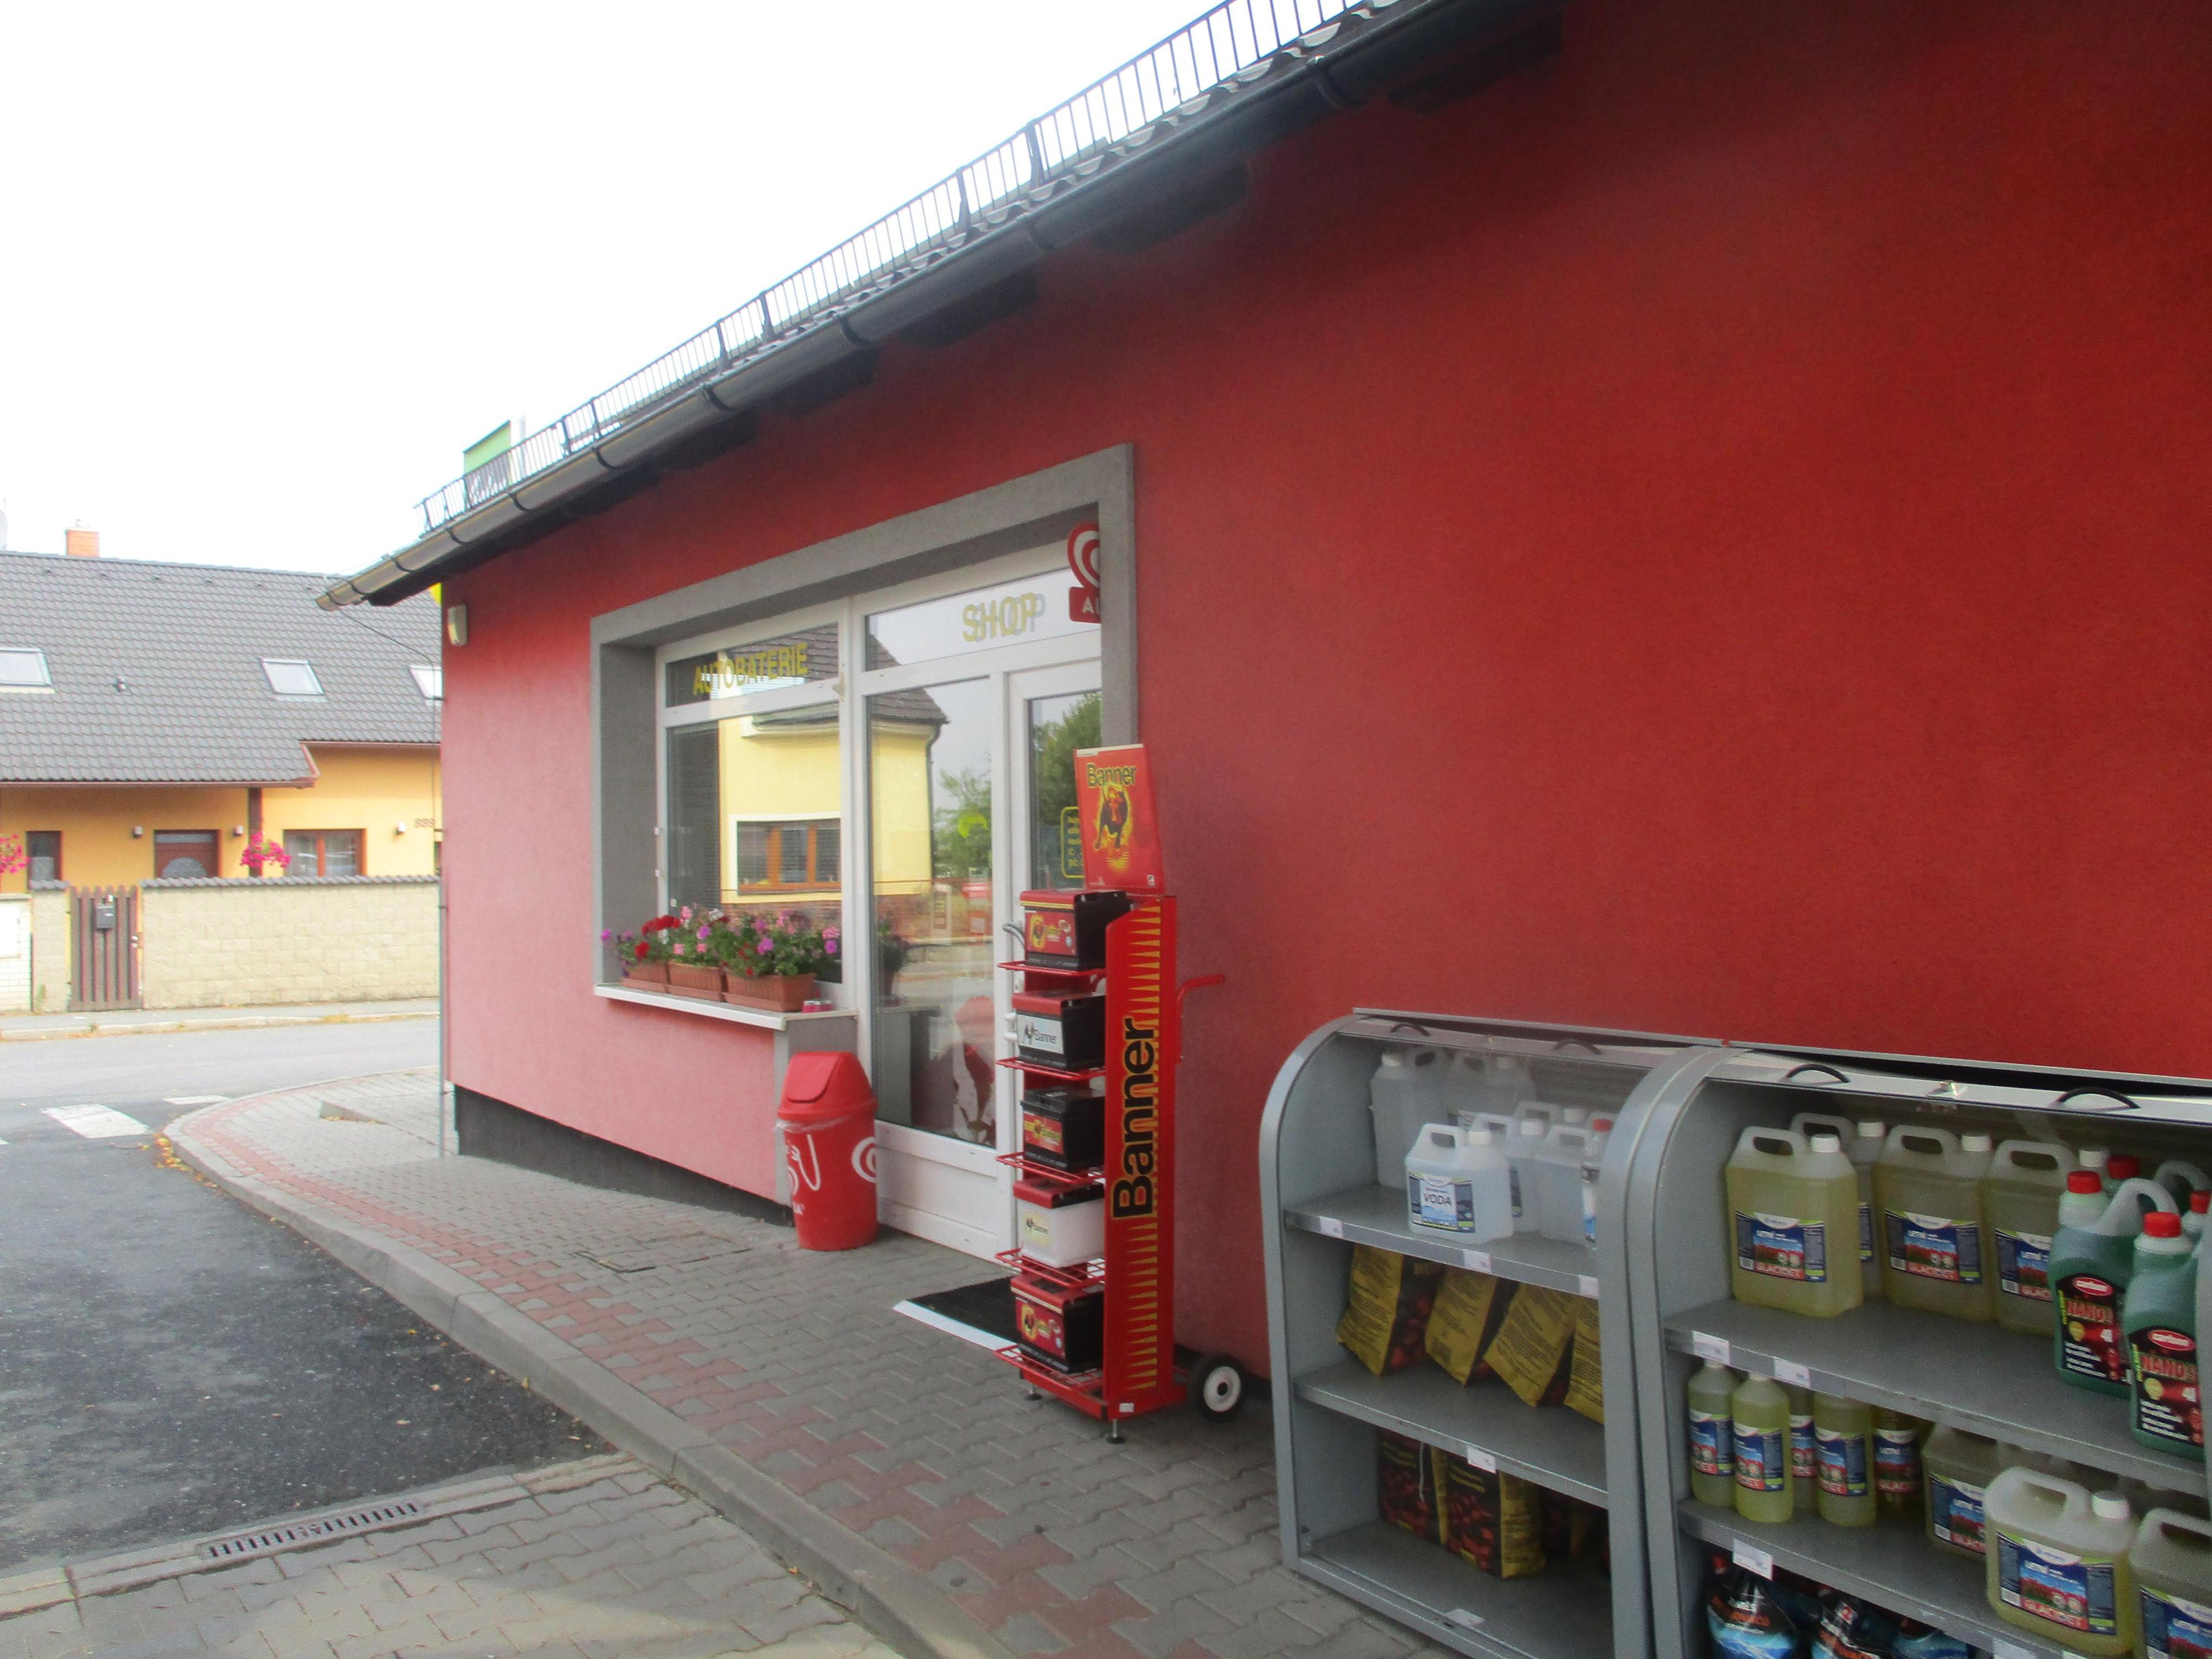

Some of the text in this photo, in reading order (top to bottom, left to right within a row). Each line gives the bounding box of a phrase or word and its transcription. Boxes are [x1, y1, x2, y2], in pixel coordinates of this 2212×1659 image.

[962, 592, 1037, 643] SHOP
[693, 641, 808, 696] AUTOBATERIE
[1087, 762, 1137, 788] Banner
[1112, 1017, 1156, 1219] Banner
[1423, 1192, 1453, 1207] VODA
